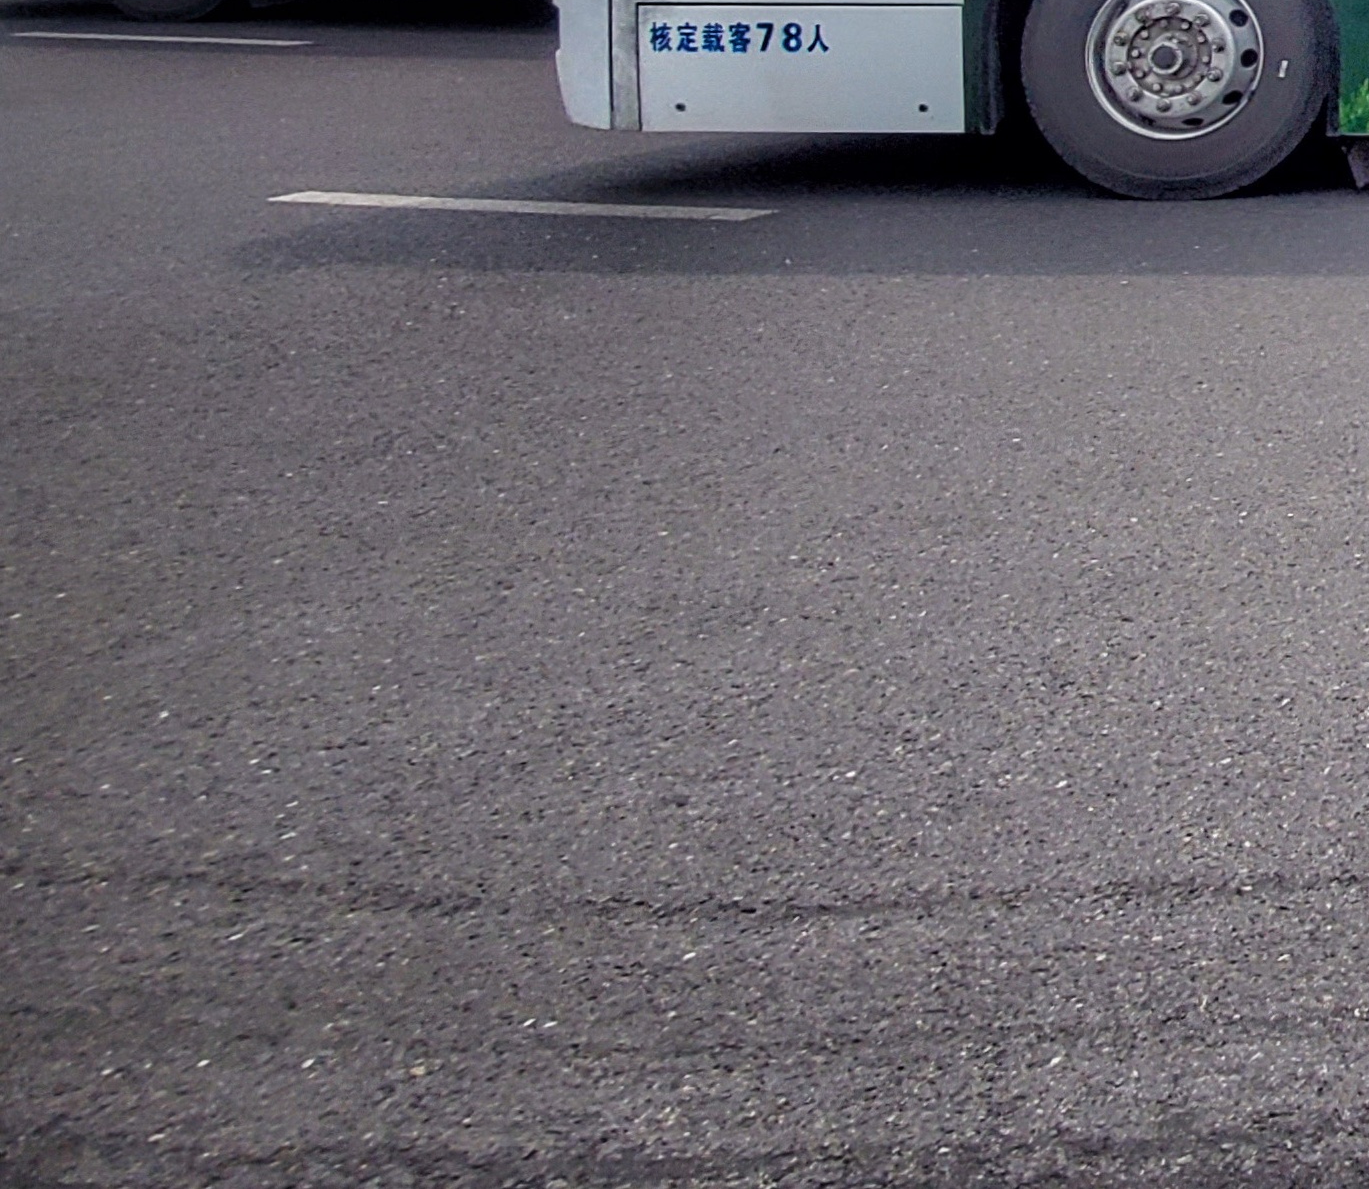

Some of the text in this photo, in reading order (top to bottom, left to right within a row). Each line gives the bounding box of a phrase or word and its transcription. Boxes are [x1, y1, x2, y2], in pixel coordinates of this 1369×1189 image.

[650, 21, 830, 53] 核定载客78人
